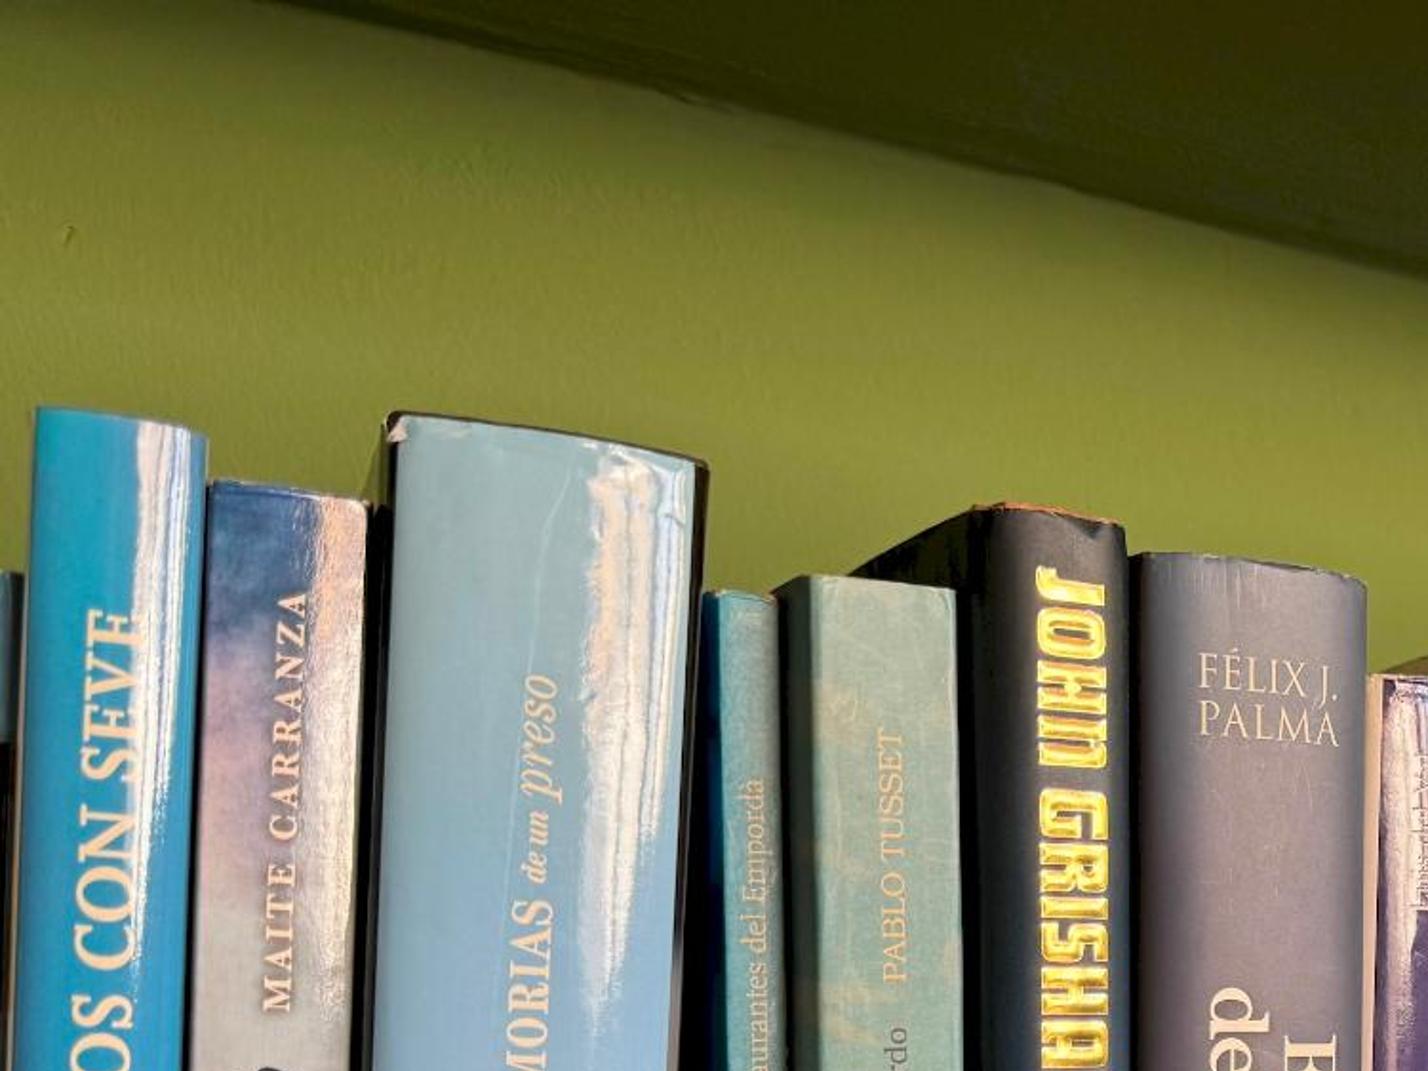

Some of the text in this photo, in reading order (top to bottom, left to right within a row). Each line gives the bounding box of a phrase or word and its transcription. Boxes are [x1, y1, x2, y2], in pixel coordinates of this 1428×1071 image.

[82, 606, 143, 784] SEVE
[1035, 564, 1108, 770] JOHN
[1199, 647, 1339, 709] FÉLIX J.
[1199, 698, 1341, 749] PALMA
[261, 590, 310, 1015] MAITE CARRANZA
[519, 673, 563, 805] preso
[74, 803, 140, 970] CON
[527, 850, 548, 885] de
[532, 809, 552, 848] un
[877, 726, 912, 985] PABLO TUSSET
[740, 914, 767, 954] del
